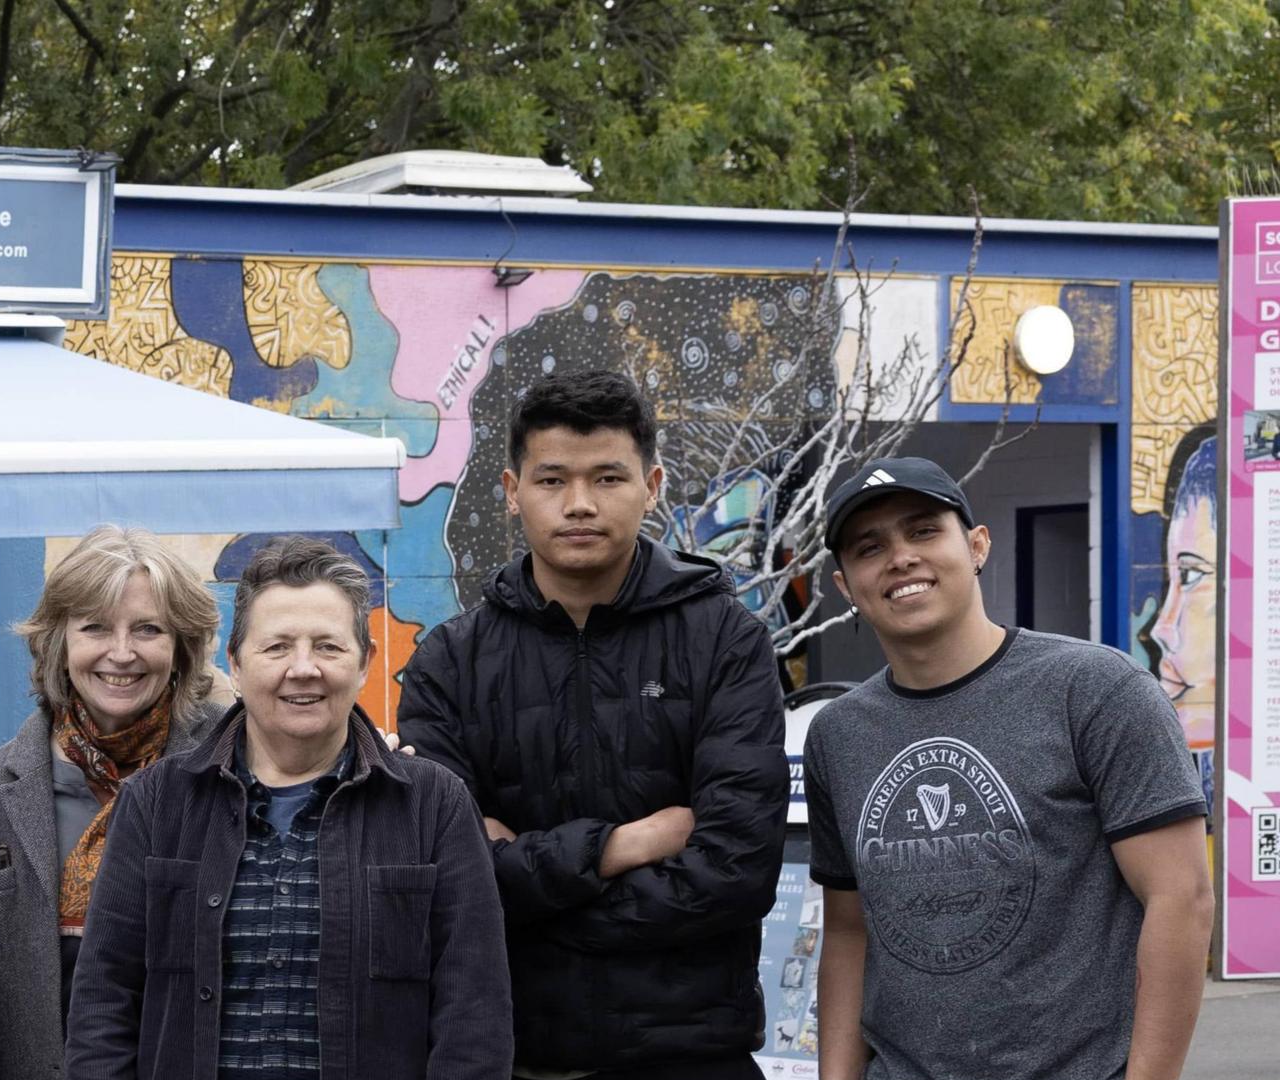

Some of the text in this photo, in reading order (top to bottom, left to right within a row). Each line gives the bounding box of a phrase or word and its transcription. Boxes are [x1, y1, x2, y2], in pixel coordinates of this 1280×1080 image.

[866, 748, 1007, 830] FOREIGN EXTRA STOUT
[905, 808, 919, 822] 17
[953, 803, 967, 818] 59
[861, 828, 1024, 875] GUINNESS
